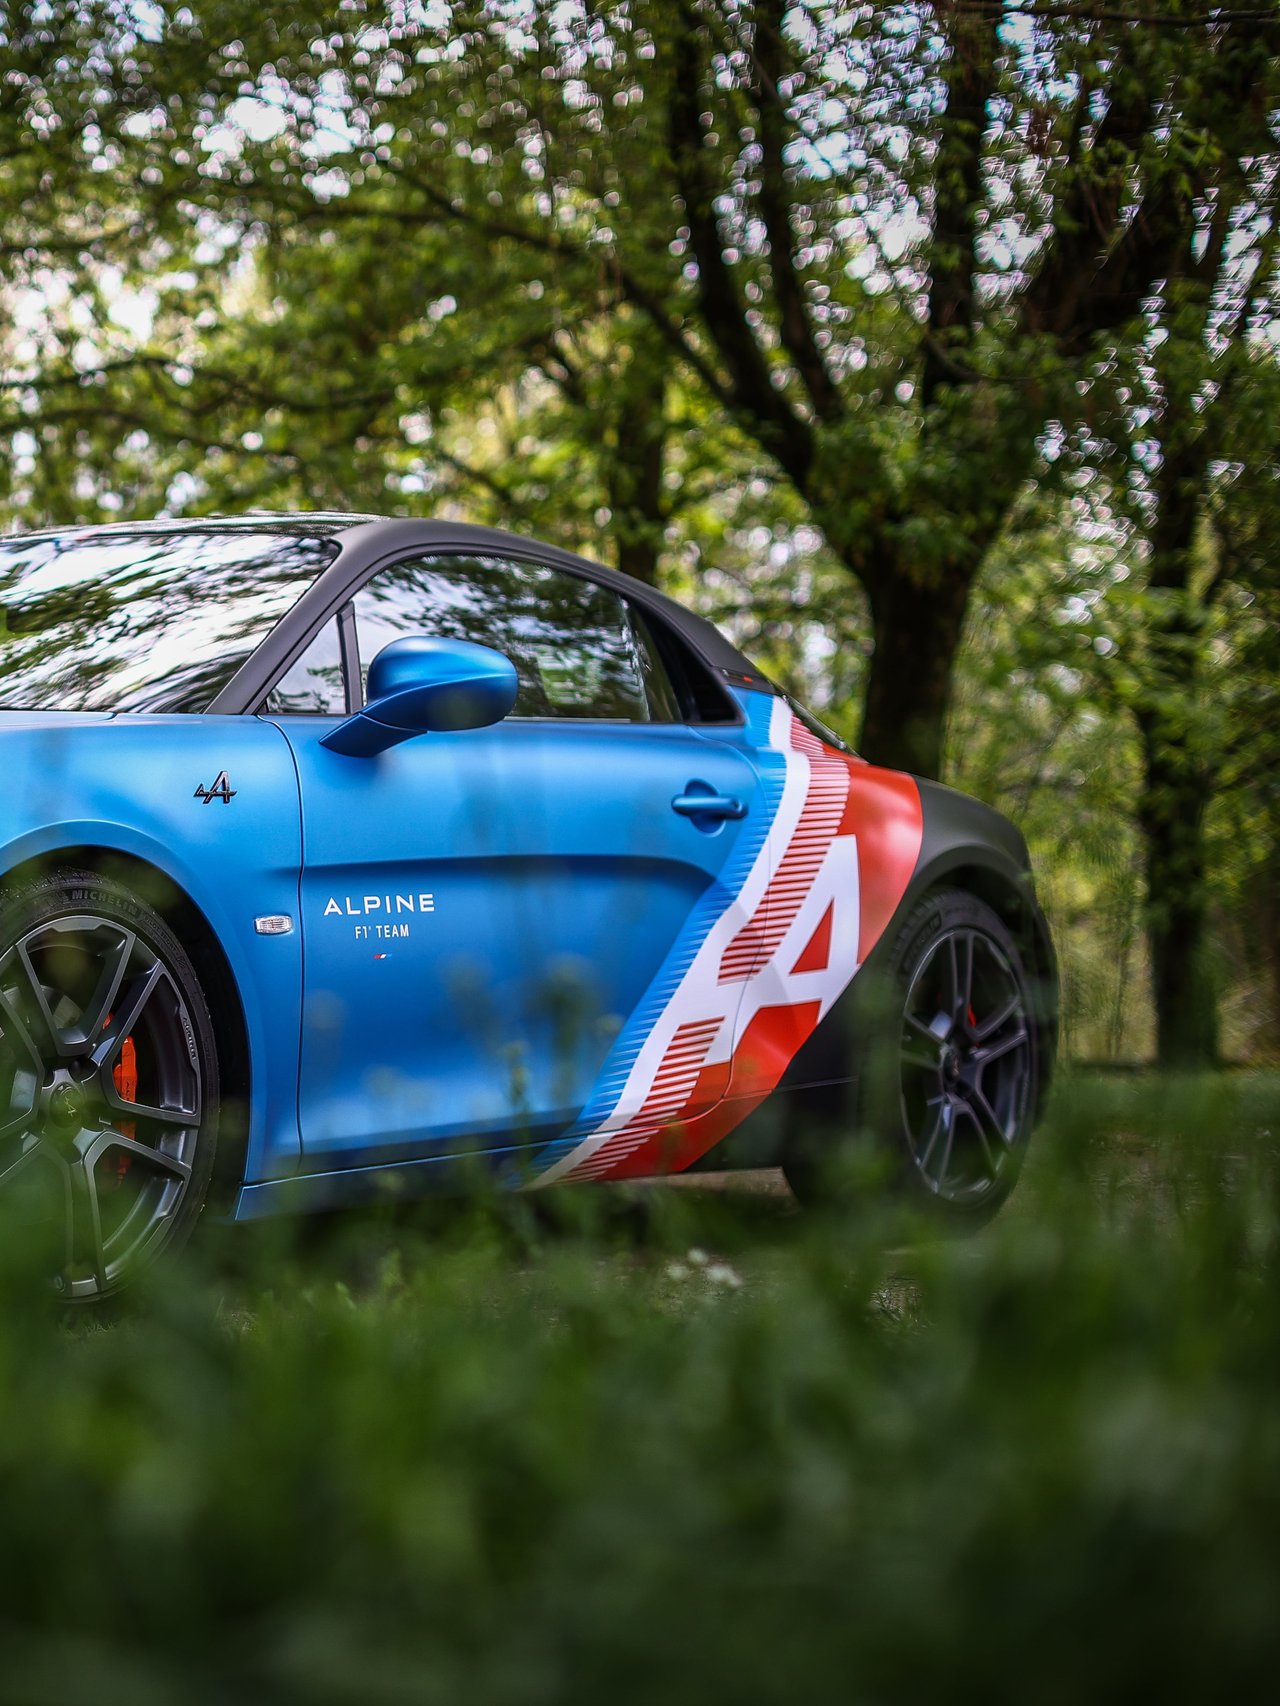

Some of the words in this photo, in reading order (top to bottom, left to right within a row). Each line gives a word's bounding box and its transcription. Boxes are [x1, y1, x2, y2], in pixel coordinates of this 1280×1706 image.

[72, 889, 138, 916] MICHELIN
[323, 893, 435, 916] ALPINE
[376, 924, 410, 938] TEAM
